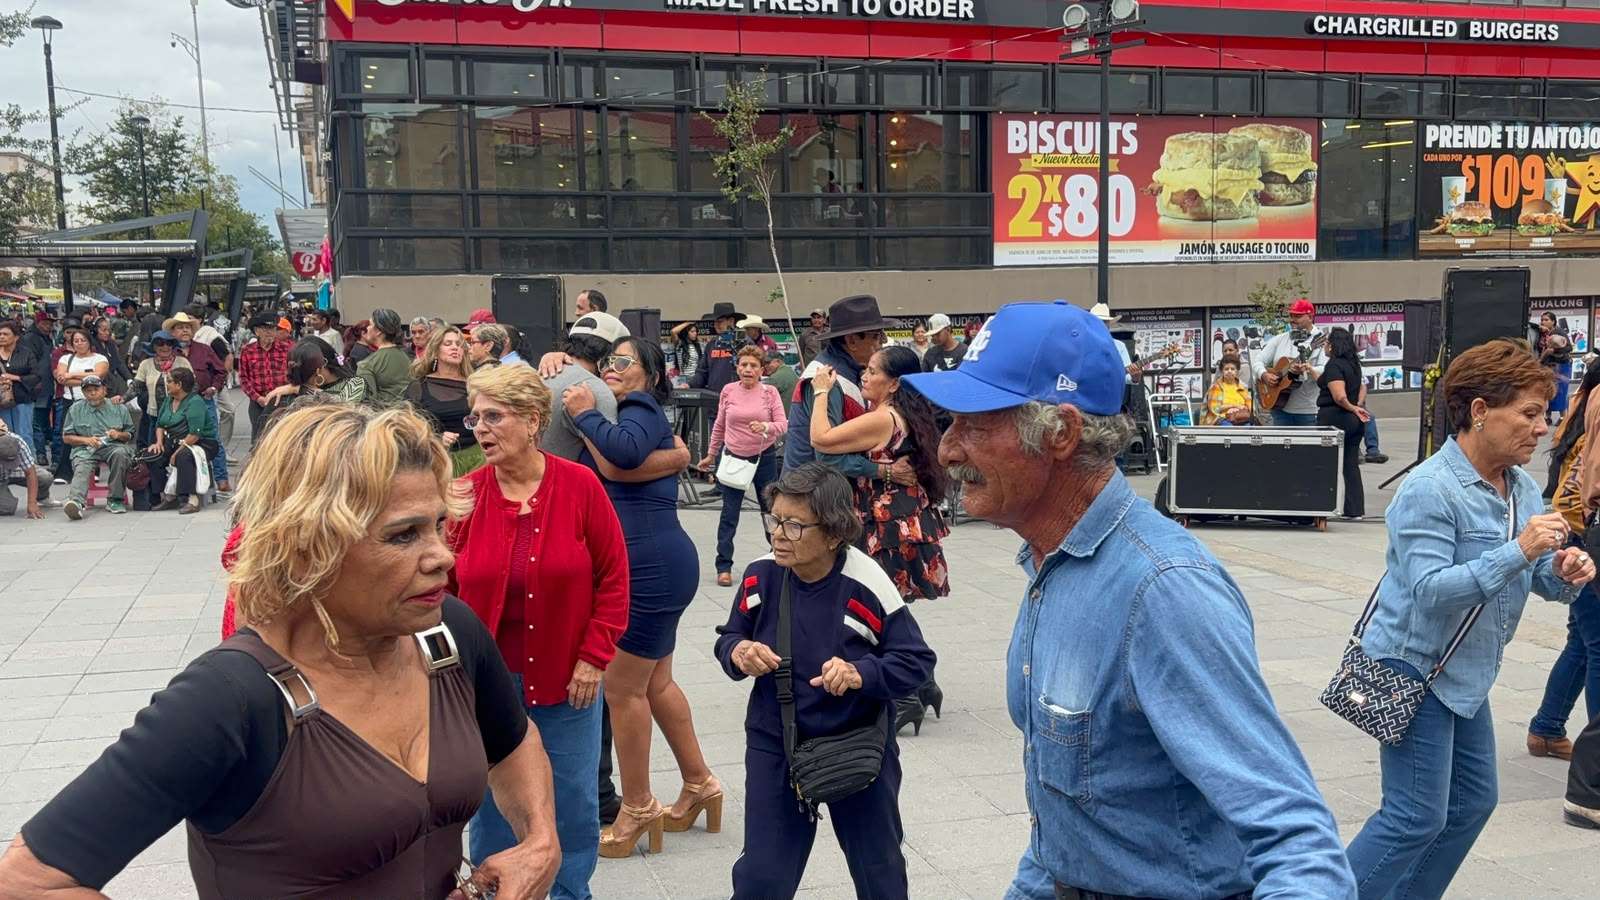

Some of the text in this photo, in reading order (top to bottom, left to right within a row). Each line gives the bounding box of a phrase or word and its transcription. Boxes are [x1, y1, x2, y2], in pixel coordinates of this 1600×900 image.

[889, 0, 975, 18] ORDER
[1313, 15, 1559, 41] CHARGRILLED BURGERS
[1007, 120, 1138, 155] BISCUITS
[1425, 125, 1600, 149] PRENDE TU ANTOJO
[1038, 153, 1069, 165] Nueva
[1461, 154, 1545, 209] $109
[1220, 242, 1263, 255] SAUSAGE
[1266, 243, 1272, 254] O
[1275, 242, 1309, 255] TOCINO
[1316, 303, 1404, 314] MAYOREO Y MENUDEO
[1531, 299, 1583, 308] HUALONG
